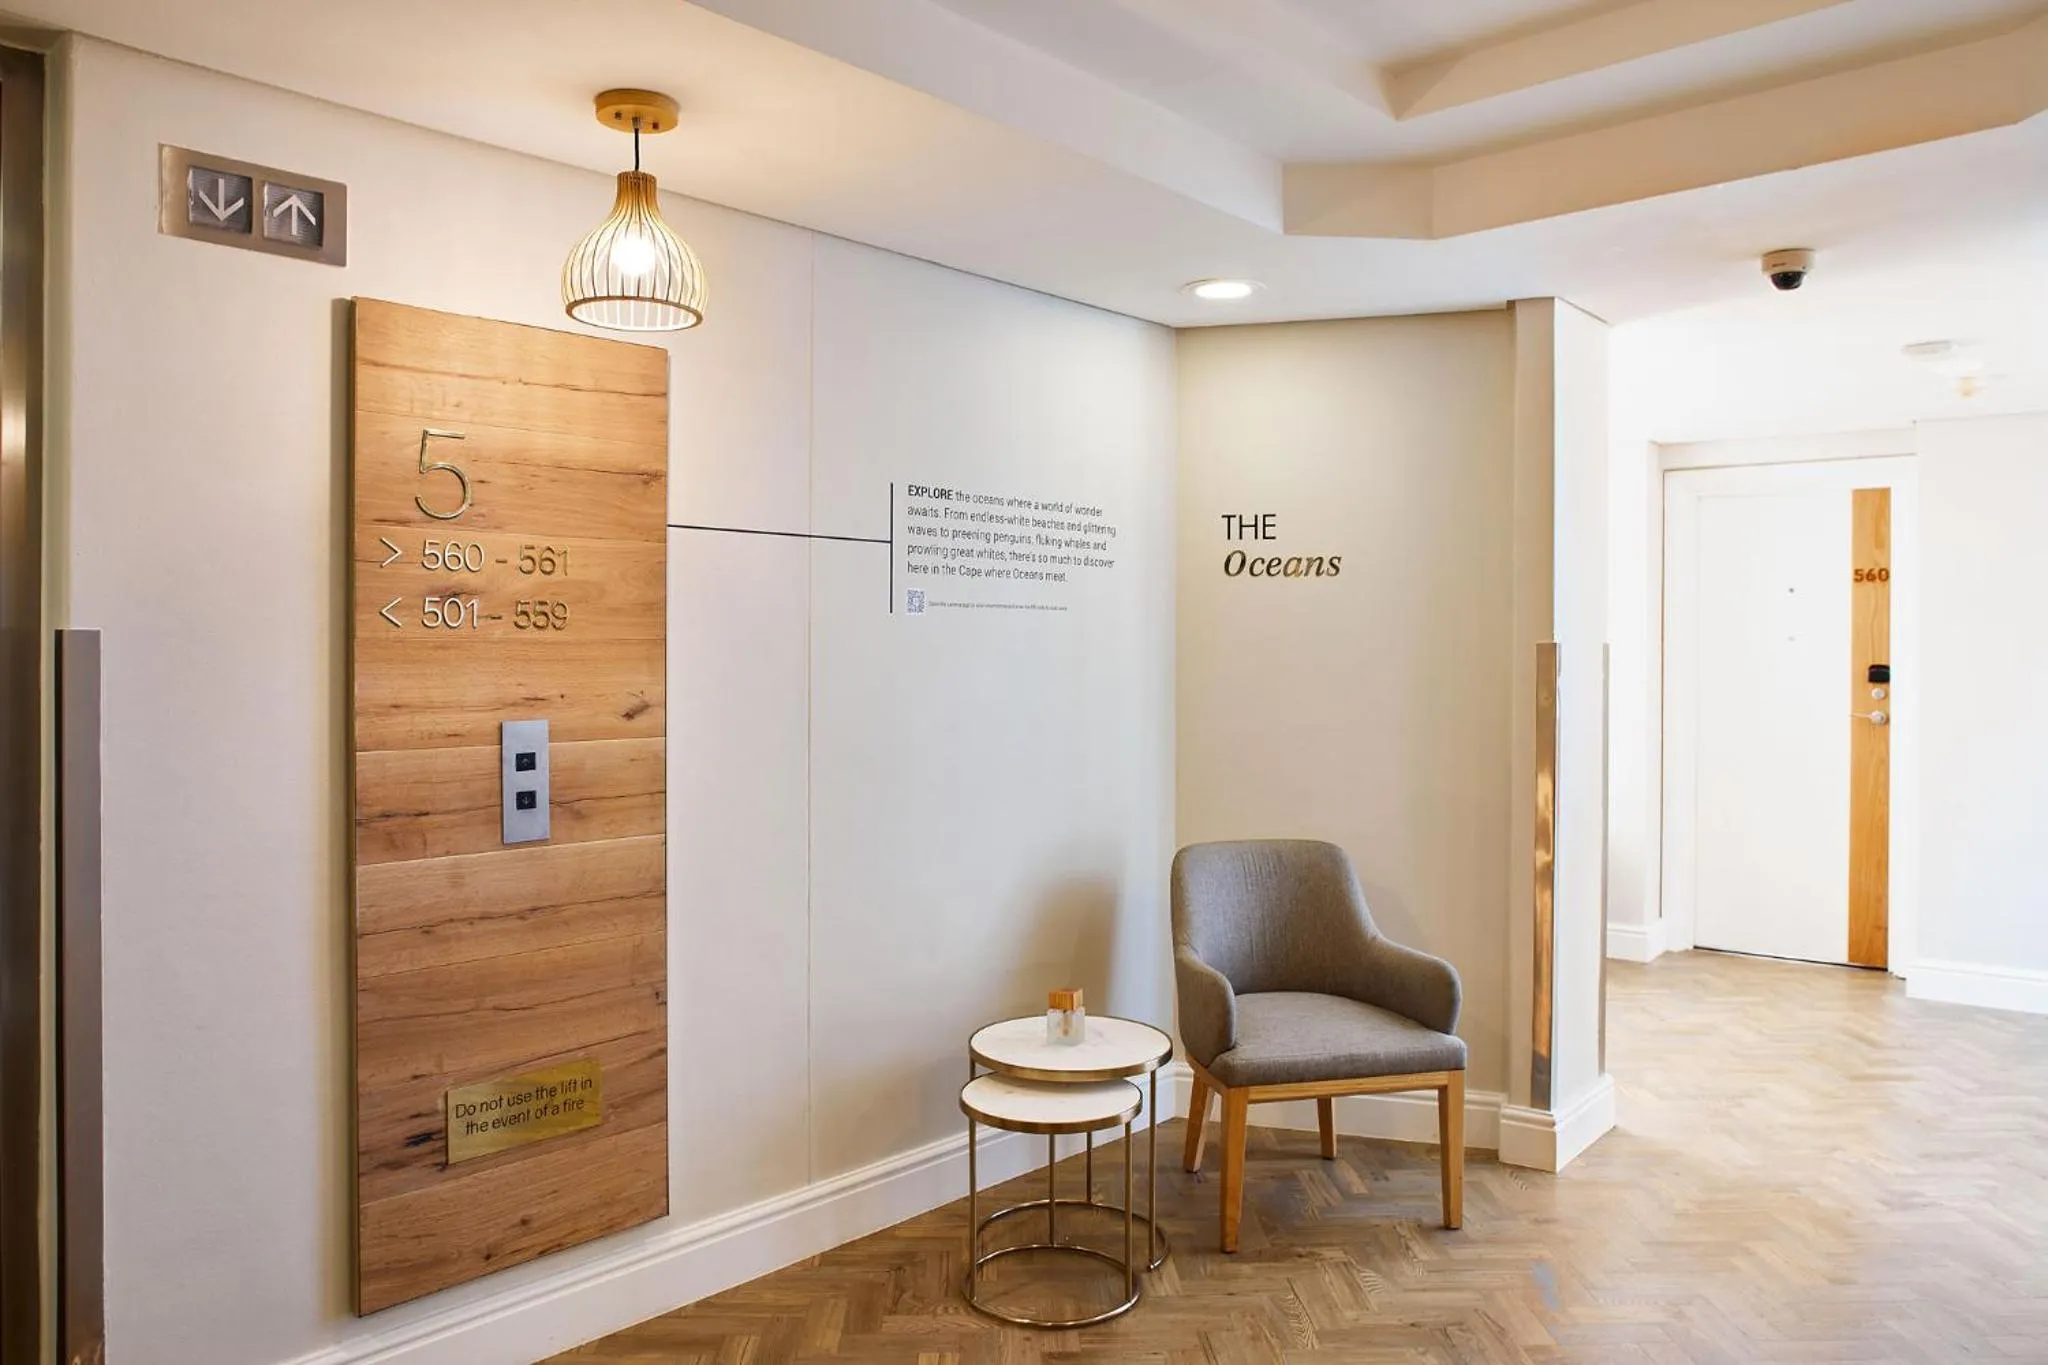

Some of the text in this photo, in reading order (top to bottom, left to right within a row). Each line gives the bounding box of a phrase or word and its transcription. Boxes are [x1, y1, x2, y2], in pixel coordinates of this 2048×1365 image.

[414, 428, 472, 520] 5
[907, 484, 1102, 517] EXPLORE the oceans where a world of wonder
[907, 506, 1116, 538] awaits. From endless-white beaches and glittering
[1221, 513, 1276, 541] THE
[907, 526, 937, 537] waves
[940, 527, 949, 537] to
[952, 529, 991, 544] preening
[1064, 537, 1091, 549] whales
[1093, 540, 1107, 551] and
[421, 540, 484, 573] 560
[519, 545, 569, 577] 561
[907, 544, 948, 559] prowling
[950, 547, 974, 560] great
[976, 547, 1007, 562] whites,
[1039, 554, 1048, 564] so
[1050, 554, 1072, 565] much
[1073, 556, 1081, 566] to
[1083, 555, 1115, 568] discover
[907, 561, 1067, 583] here in the Cape where Oceans meet.
[1223, 549, 1342, 578] Oceans
[1853, 568, 1889, 583] 560
[421, 597, 480, 629] 501
[513, 600, 569, 631] 559
[455, 1076, 593, 1119] Do not use the lift in
[465, 1097, 585, 1136] the event of a fire
